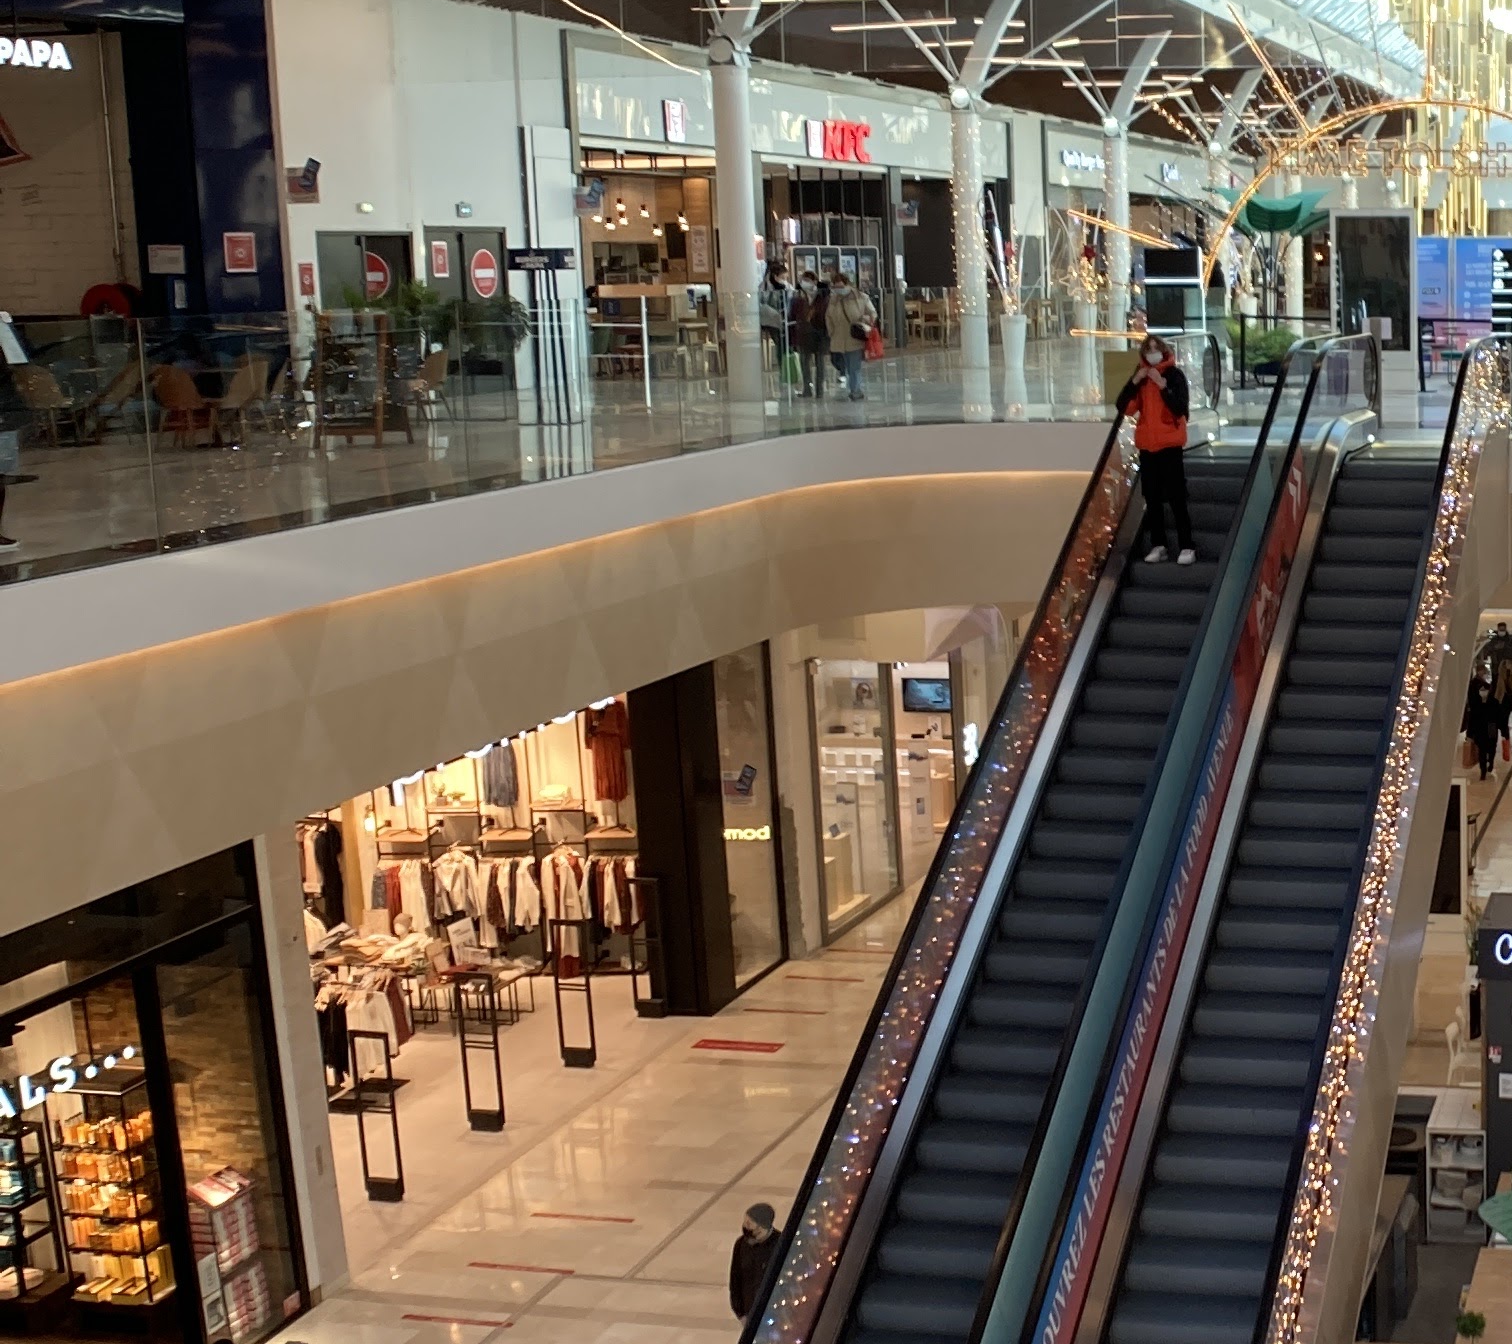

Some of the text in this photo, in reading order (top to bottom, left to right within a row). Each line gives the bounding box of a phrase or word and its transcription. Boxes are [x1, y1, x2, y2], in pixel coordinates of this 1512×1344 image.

[0, 37, 73, 70] PAPA
[823, 120, 872, 164] KFC
[1264, 137, 1368, 178] TIME
[1376, 140, 1438, 178] TO
[723, 824, 771, 841] mod
[1083, 1148, 1107, 1216] LES
[1102, 944, 1168, 1154] RESTAURANTS
[1162, 906, 1180, 946] DE
[1174, 865, 1190, 908] LA
[1185, 794, 1209, 865] FOOD
